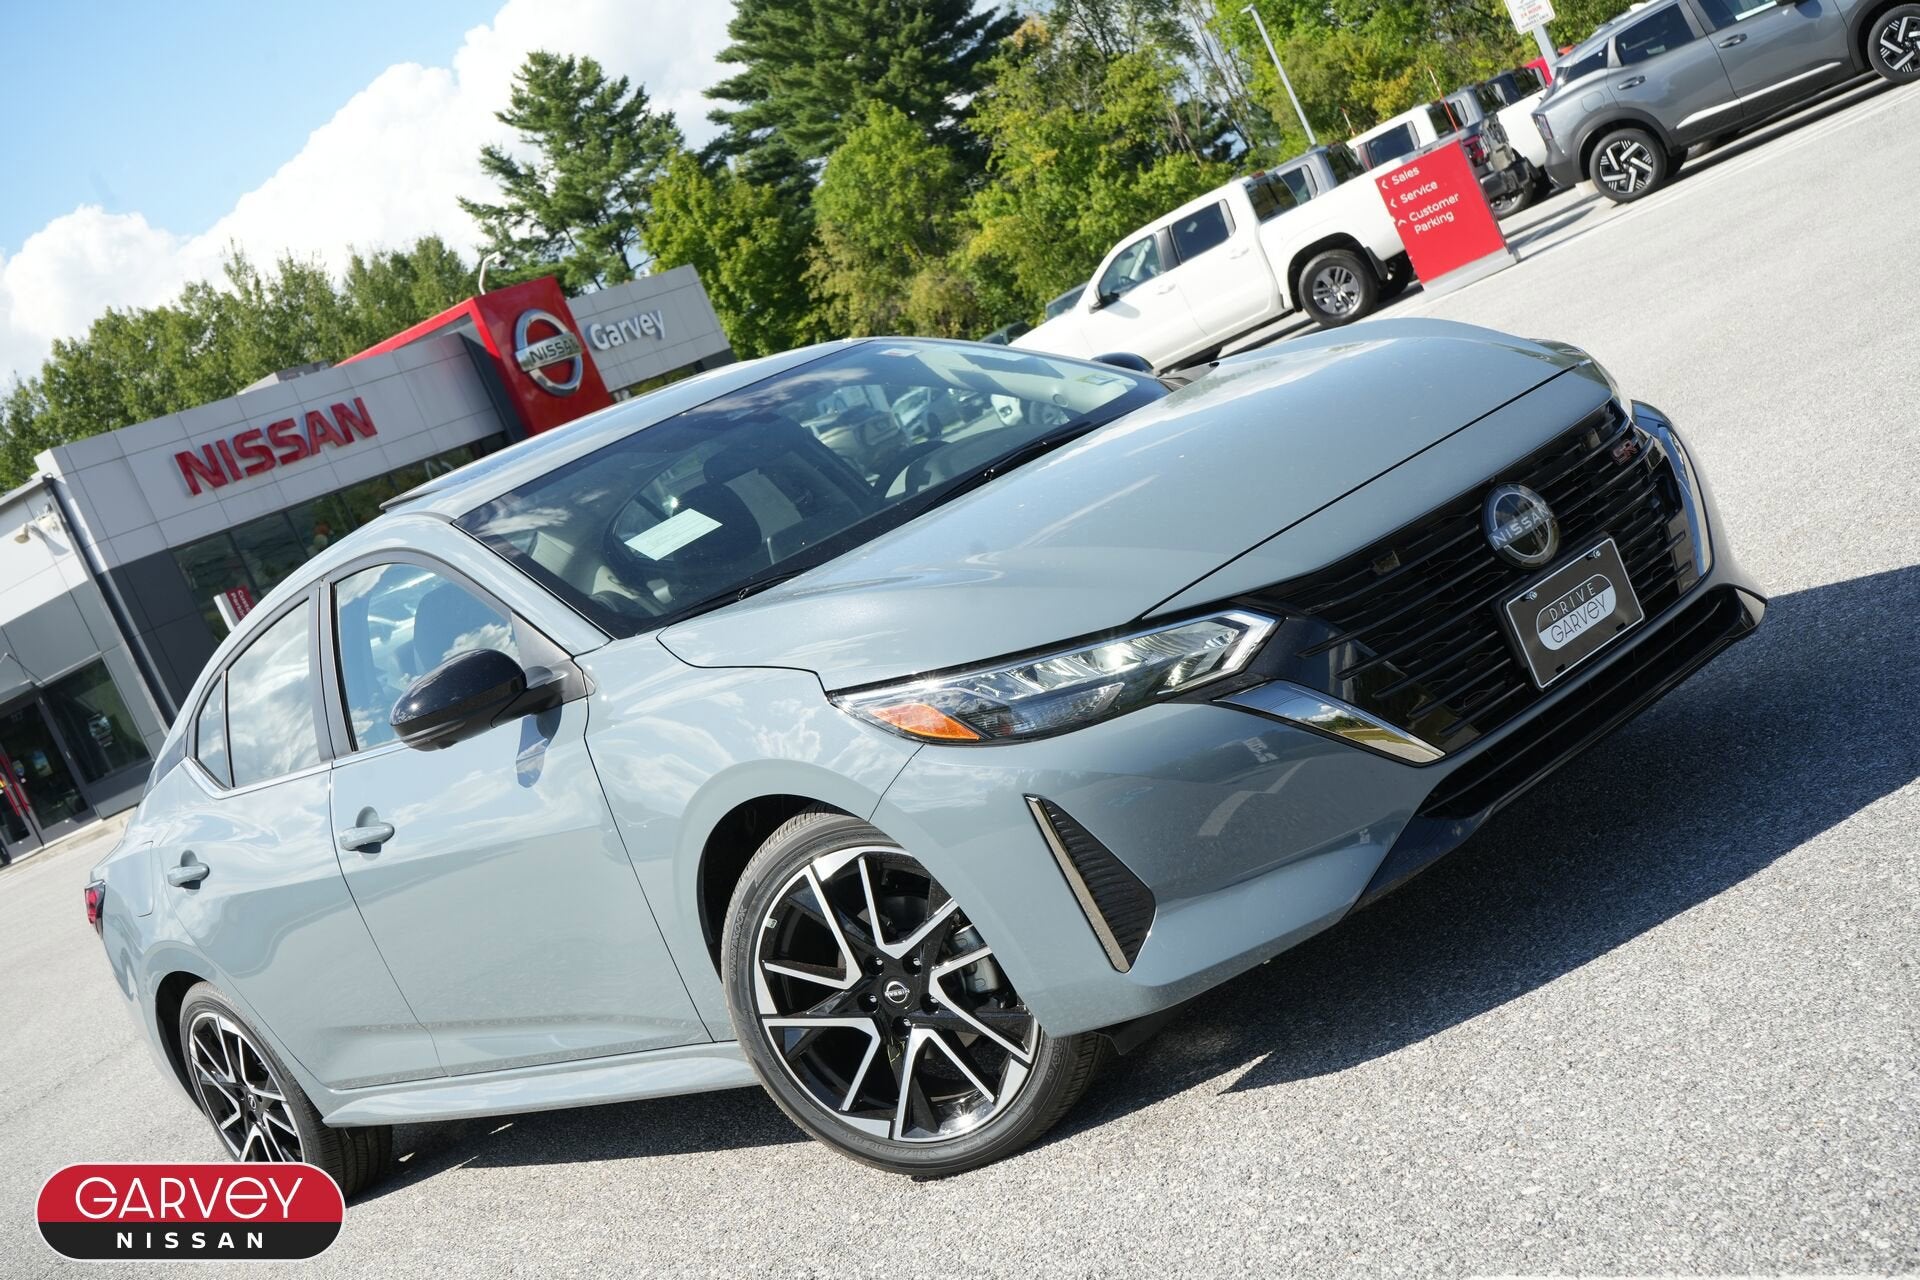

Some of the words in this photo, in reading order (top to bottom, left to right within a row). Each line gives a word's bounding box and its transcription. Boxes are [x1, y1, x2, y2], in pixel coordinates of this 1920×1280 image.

[1391, 166, 1420, 185] Sales
[1400, 181, 1438, 204] Service
[1409, 193, 1459, 221] Customer
[1414, 211, 1454, 234] Parking
[590, 310, 665, 350] Garvey
[529, 337, 580, 363] NISSAN
[174, 397, 378, 496] NISSAN
[1492, 501, 1549, 546] NISSAN
[238, 589, 250, 613] Custo
[1549, 582, 1596, 621] DRIVE
